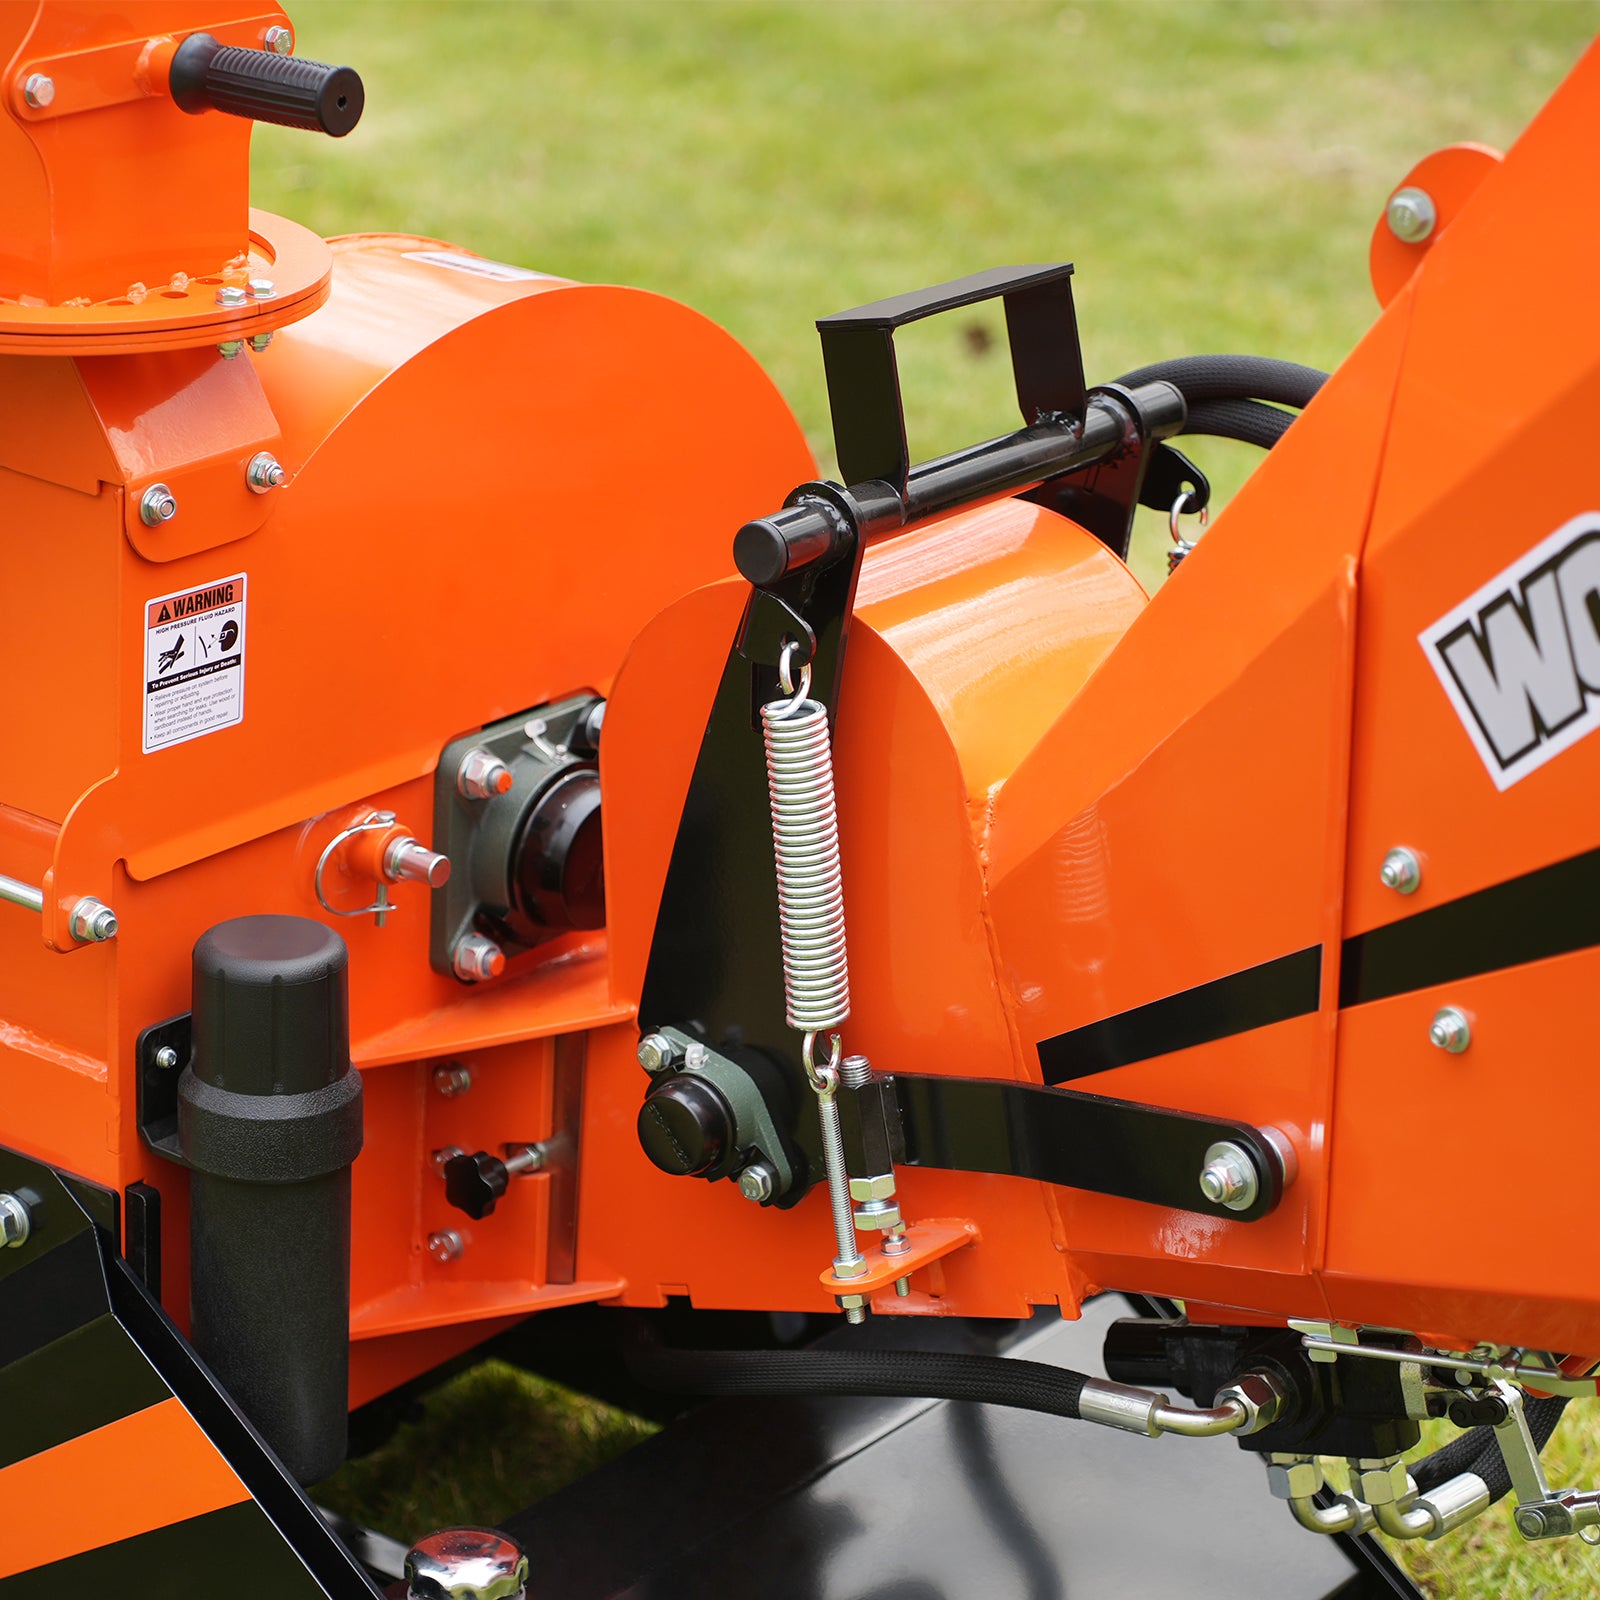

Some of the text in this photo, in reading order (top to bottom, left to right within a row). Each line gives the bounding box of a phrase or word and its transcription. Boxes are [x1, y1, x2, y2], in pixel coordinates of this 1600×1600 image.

[173, 584, 233, 618] WARNING
[156, 606, 235, 635] HIGH PRESSURE FLUID HAZARD
[160, 678, 179, 687] Prevent
[180, 670, 198, 680] Serious
[199, 666, 214, 676] Injury
[171, 686, 190, 697] pressure
[214, 674, 228, 683] before
[154, 698, 174, 708] repairing
[167, 704, 181, 714] proper
[167, 709, 188, 720] searching
